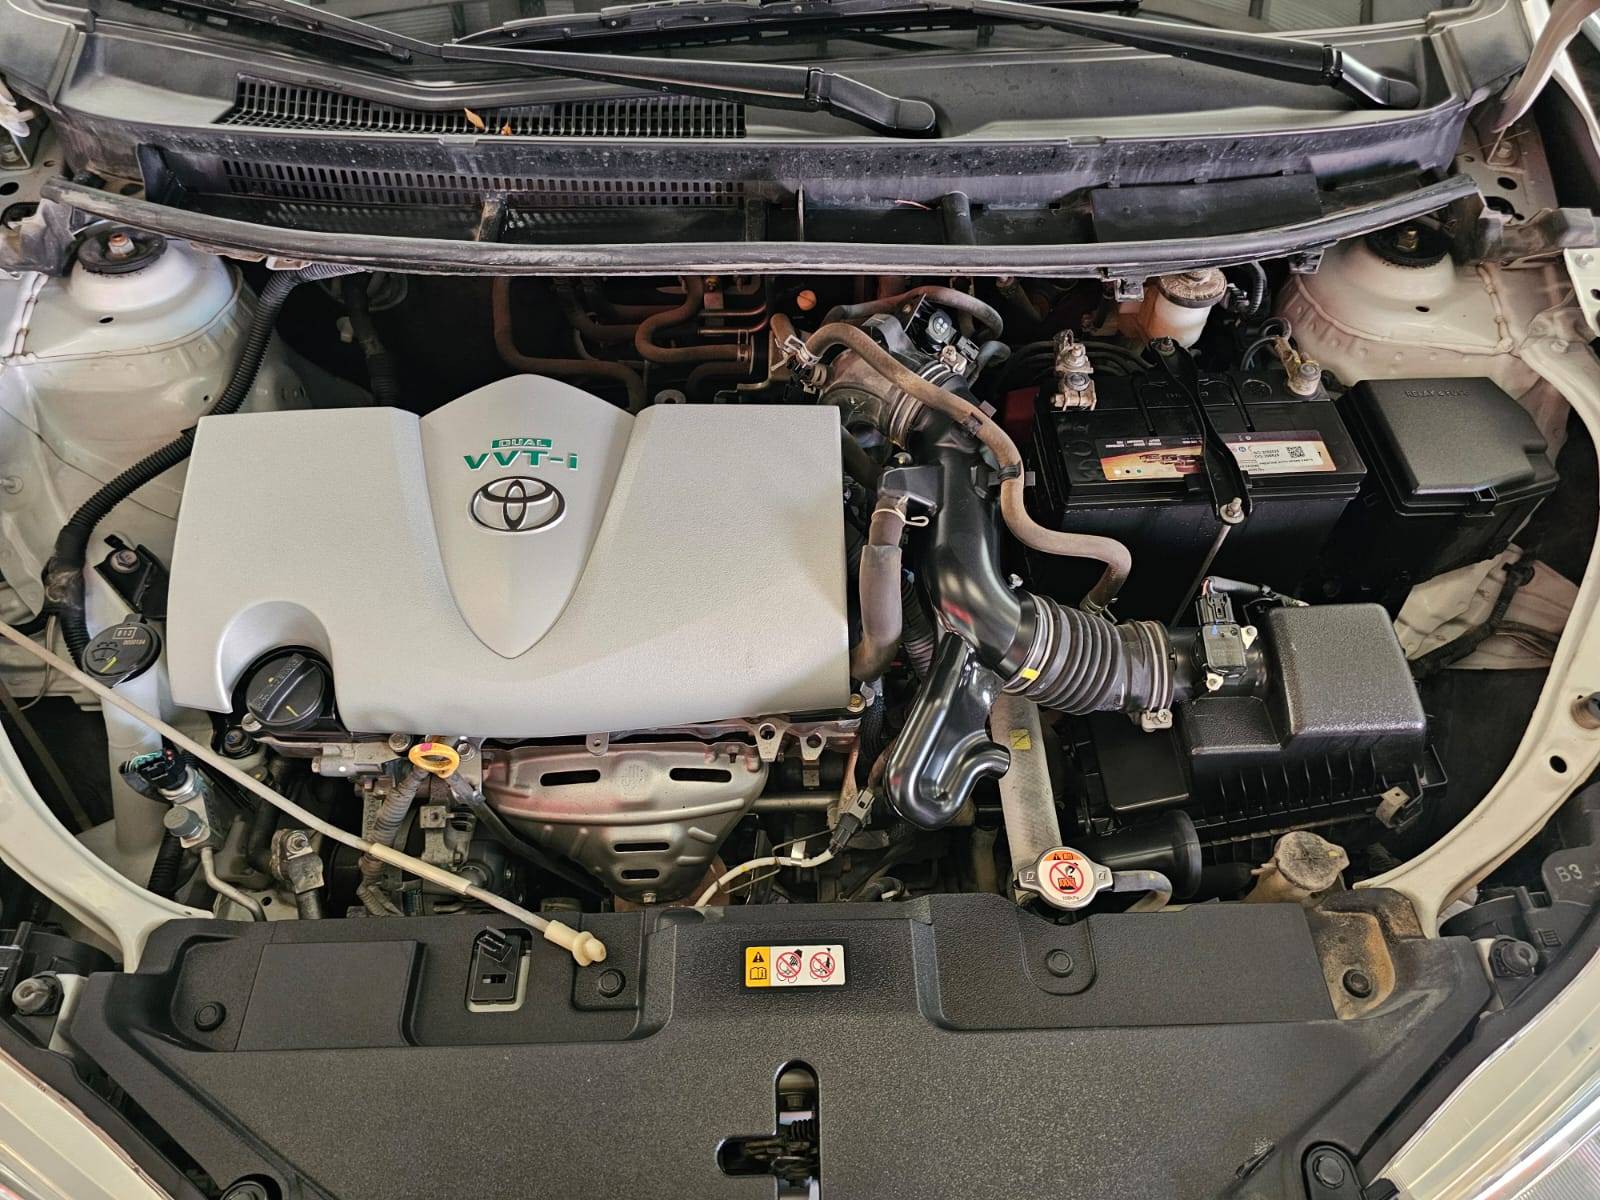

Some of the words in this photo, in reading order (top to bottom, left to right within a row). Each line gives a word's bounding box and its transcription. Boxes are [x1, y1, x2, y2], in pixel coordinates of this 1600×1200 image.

[498, 439, 548, 447] DUAL
[463, 449, 578, 471] VVT-i
[1554, 863, 1583, 882] B3
